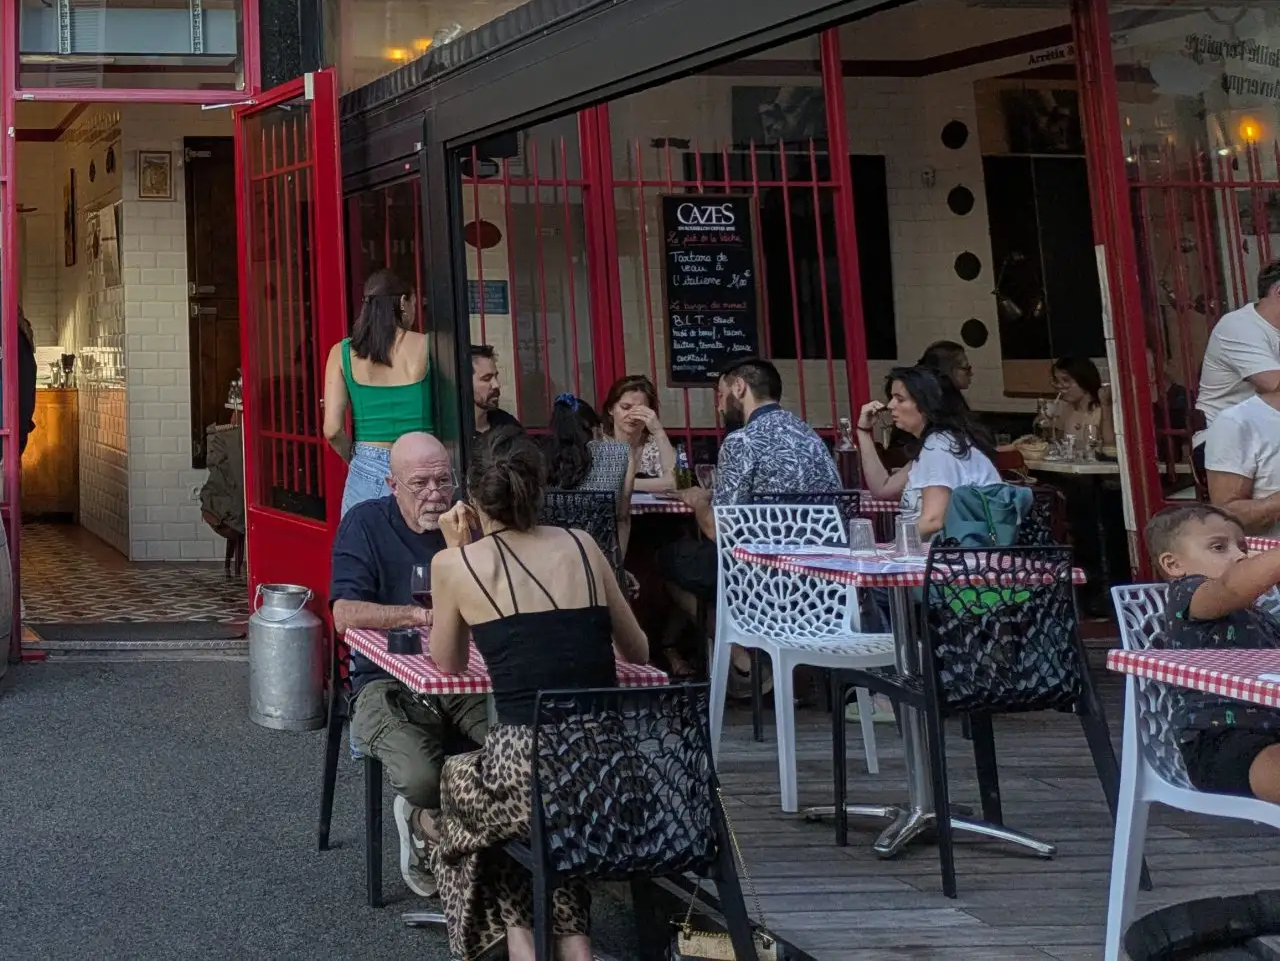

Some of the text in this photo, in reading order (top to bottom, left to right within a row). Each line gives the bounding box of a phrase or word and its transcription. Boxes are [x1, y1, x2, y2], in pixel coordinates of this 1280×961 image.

[677, 203, 735, 225] CAZES
[669, 250, 729, 263] Tartare de
[681, 264, 708, 272] veau
